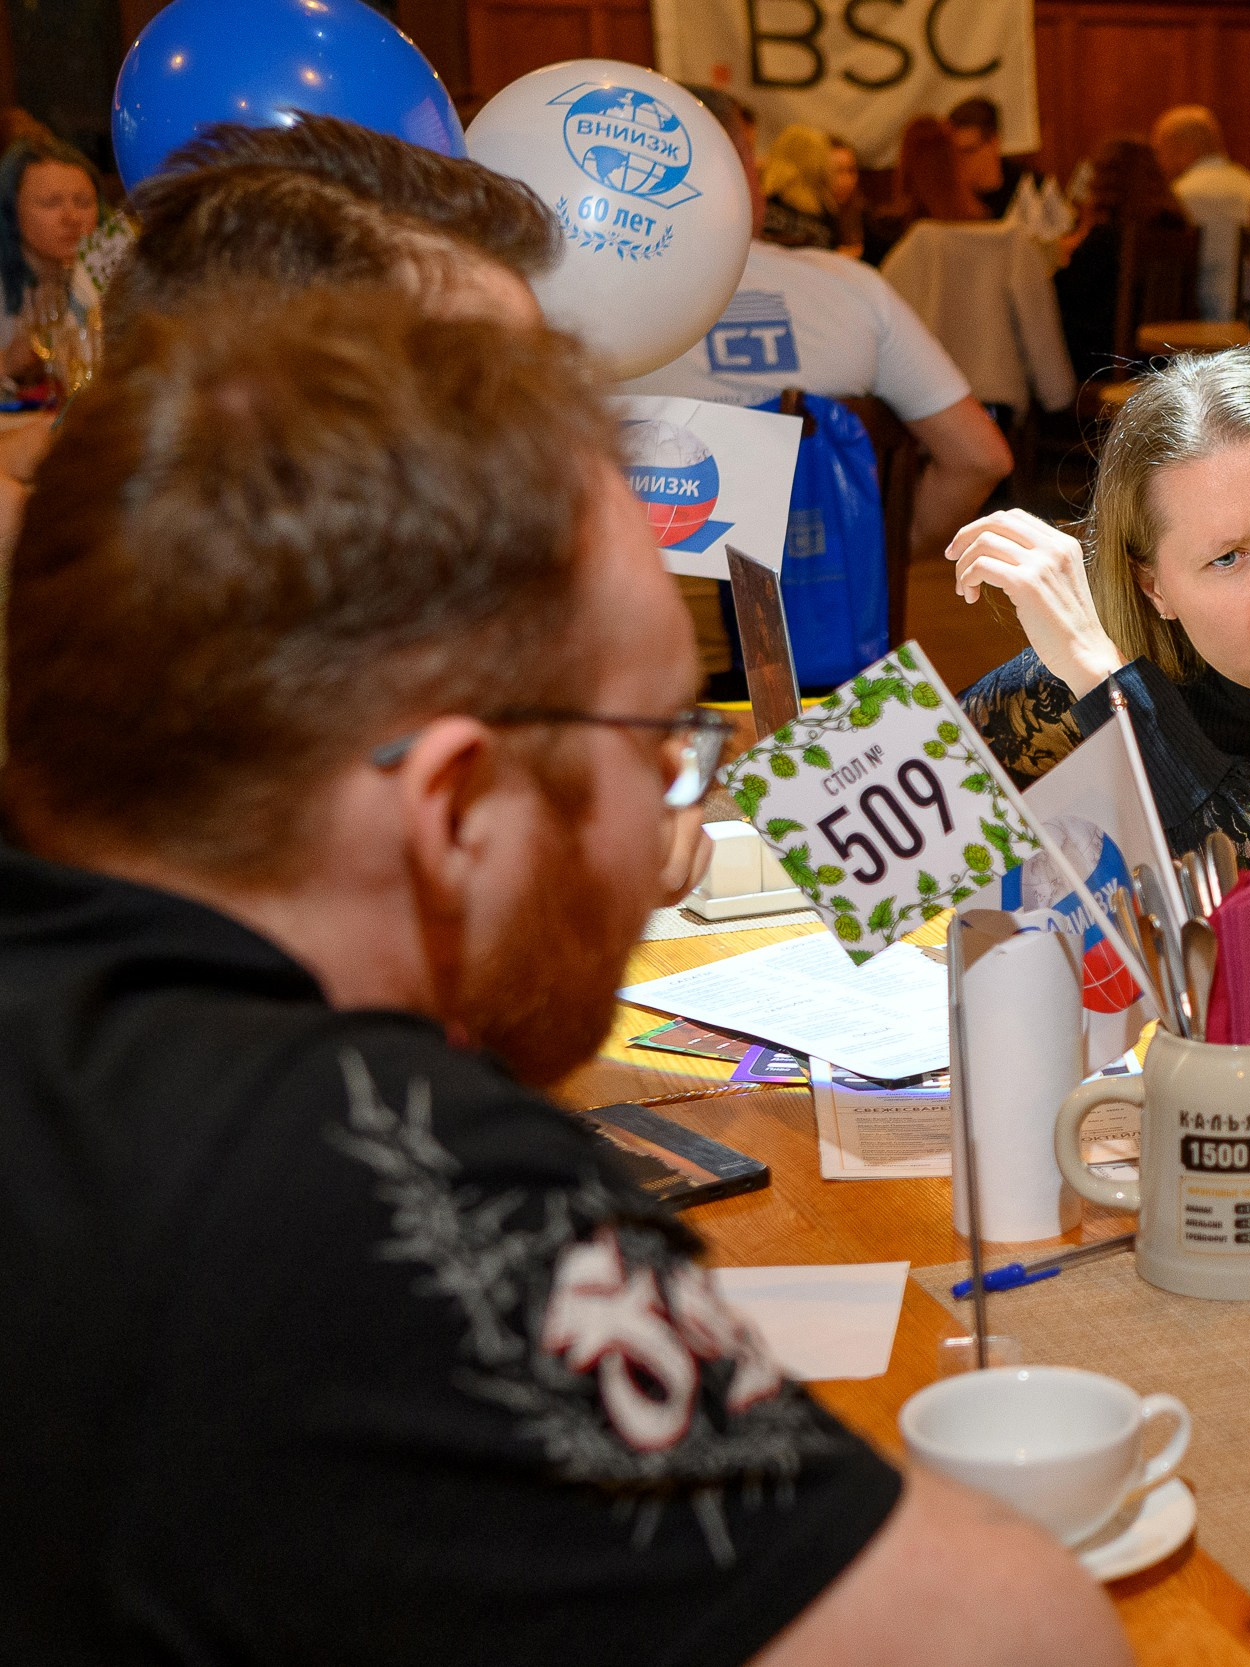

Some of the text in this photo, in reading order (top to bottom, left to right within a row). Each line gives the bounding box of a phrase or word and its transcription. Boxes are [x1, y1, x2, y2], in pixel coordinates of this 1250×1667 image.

[748, 0, 1000, 90] BSC
[577, 119, 681, 161] ВНИИЗЖ
[577, 195, 657, 237] 60 лет
[823, 744, 885, 797] СТОЛ №
[817, 758, 955, 886] 509
